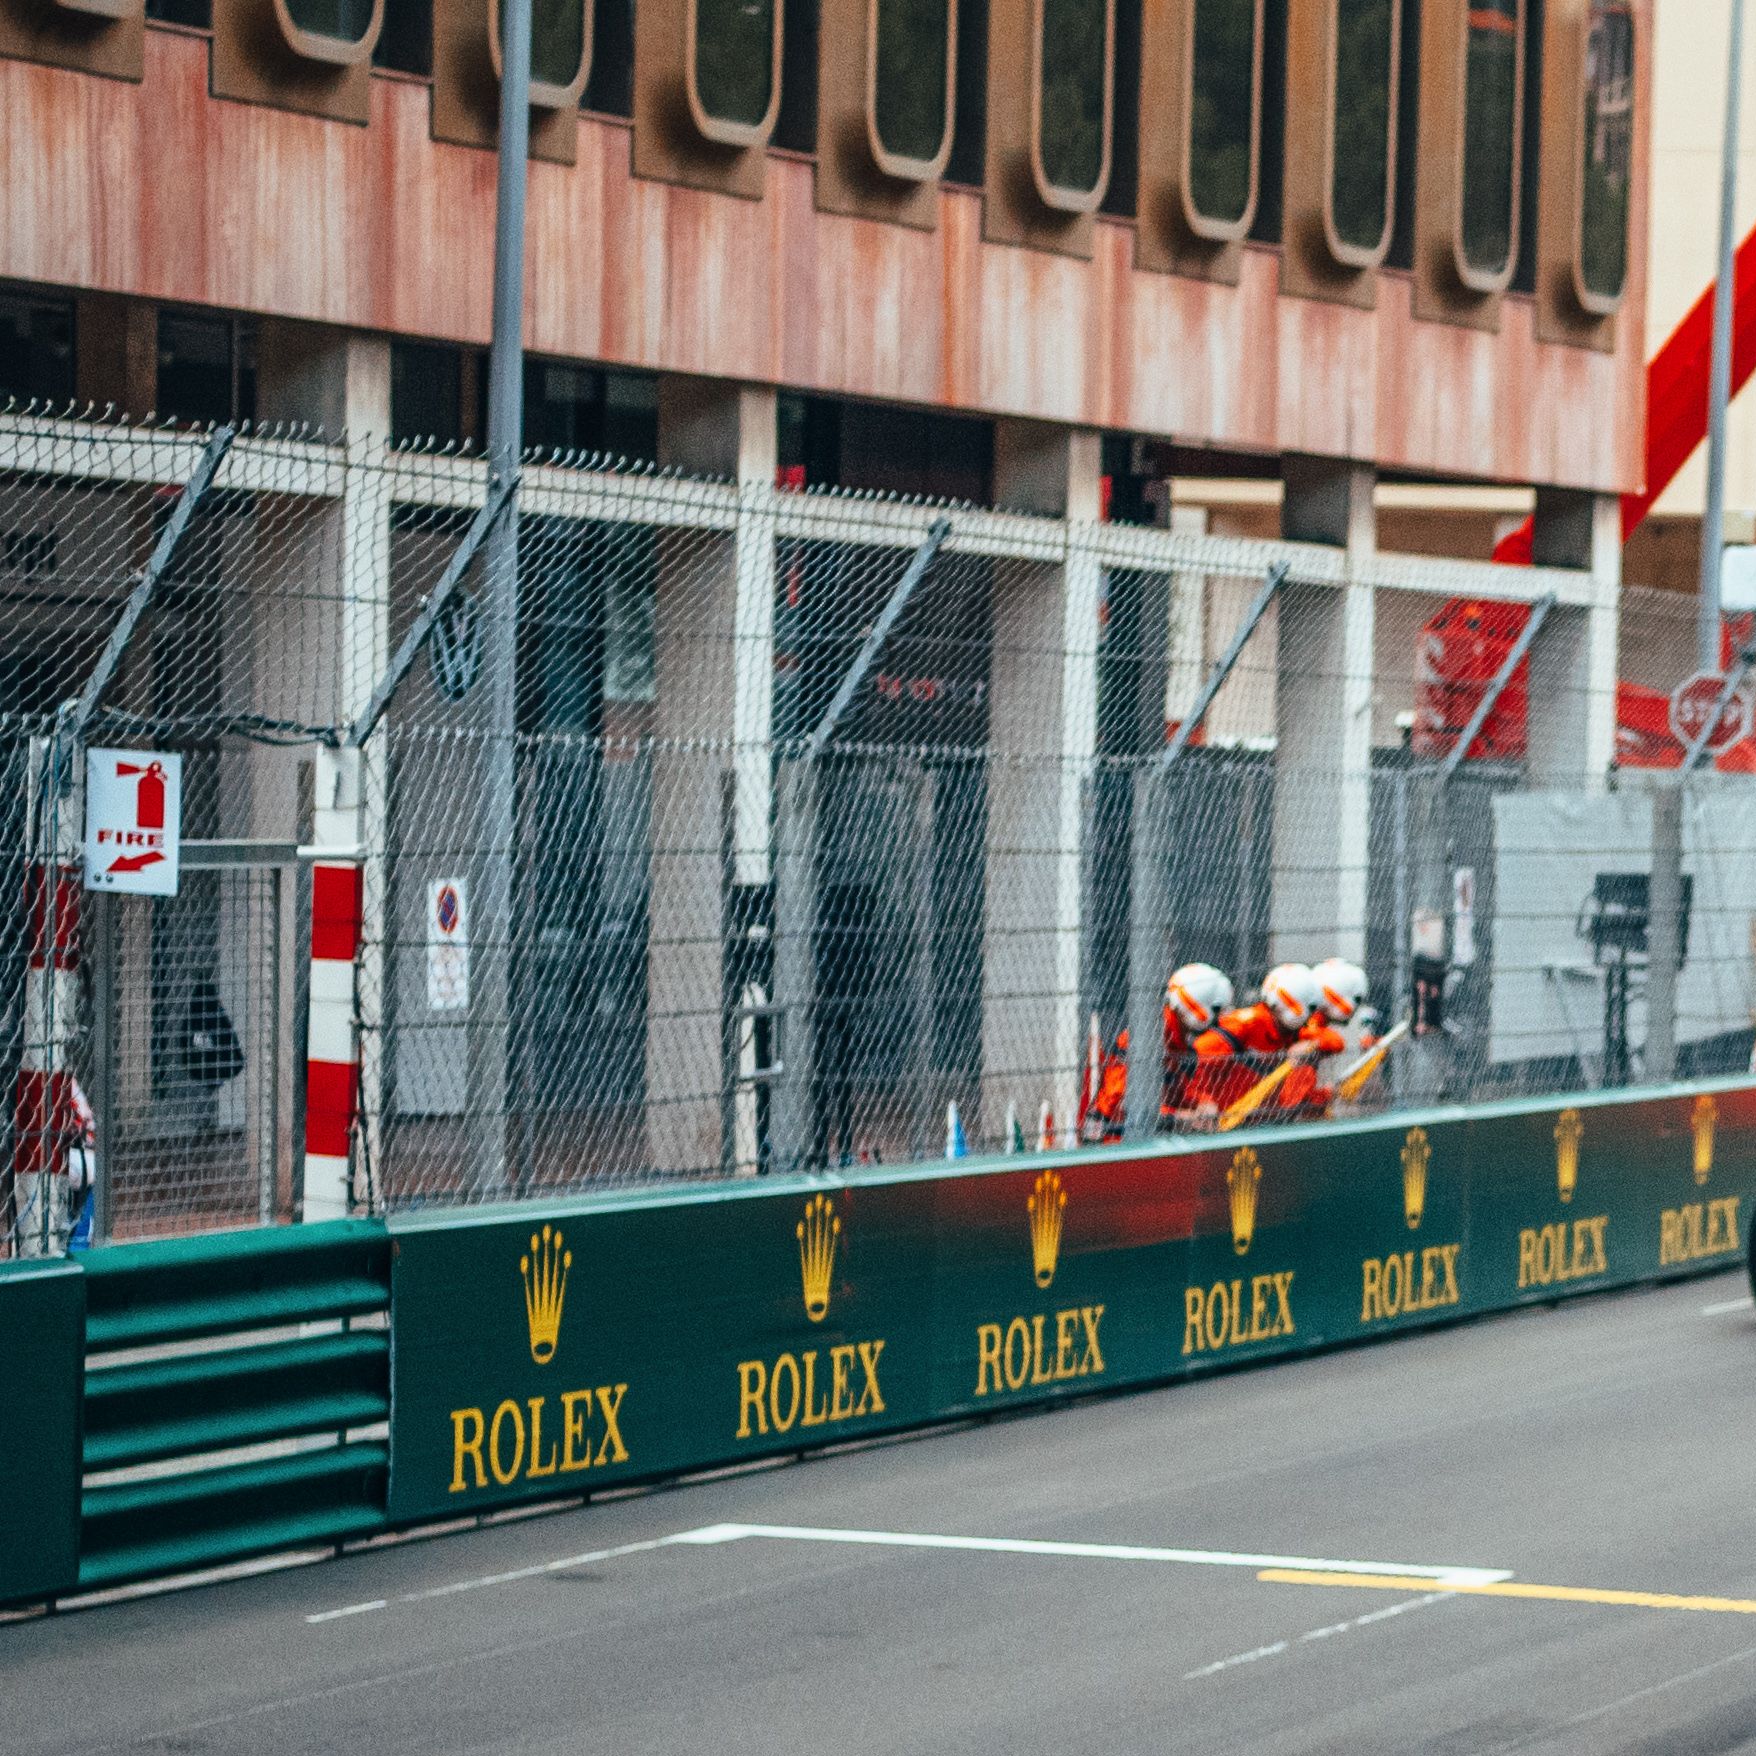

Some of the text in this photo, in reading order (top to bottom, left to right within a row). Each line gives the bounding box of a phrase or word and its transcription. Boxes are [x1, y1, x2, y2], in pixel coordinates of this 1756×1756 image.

[1680, 699, 1743, 726] STP
[97, 829, 164, 847] FIRE
[1517, 1216, 1608, 1288] ROLEX
[1658, 1196, 1741, 1266] ROLEX
[1181, 1271, 1295, 1356] ROLEX
[1360, 1244, 1460, 1322] ROLEX
[735, 1339, 886, 1438] ROLEX
[974, 1303, 1105, 1396] ROLEX
[448, 1383, 630, 1494] ROLEX
